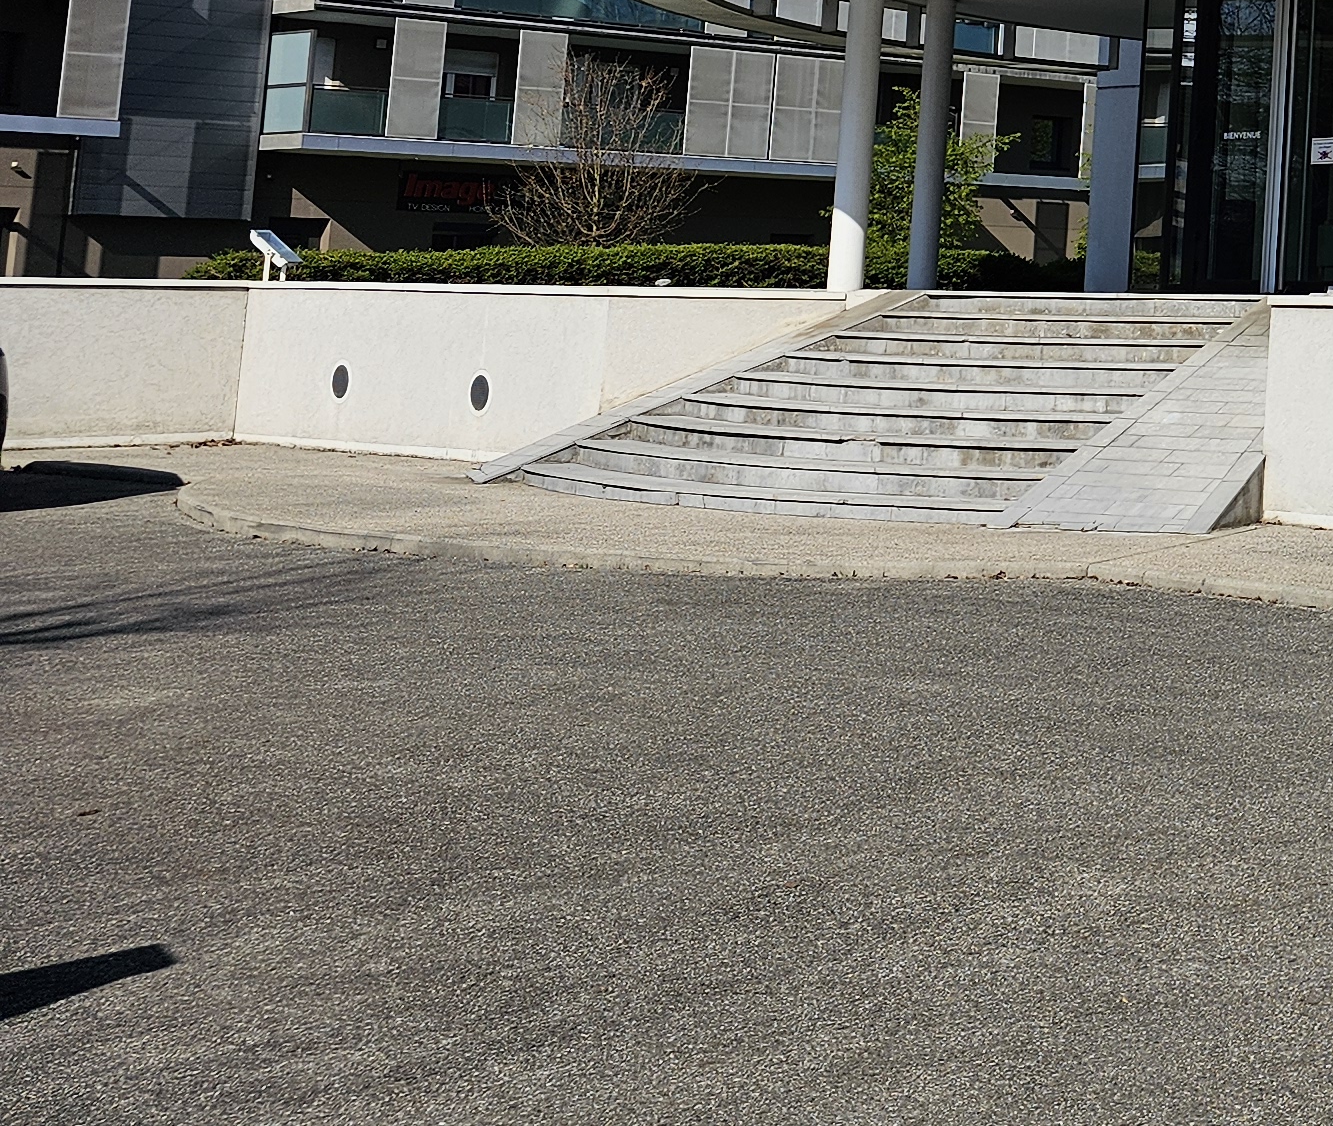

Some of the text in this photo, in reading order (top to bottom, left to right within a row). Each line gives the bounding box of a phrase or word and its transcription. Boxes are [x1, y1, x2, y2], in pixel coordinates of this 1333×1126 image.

[1223, 130, 1262, 140] BIENVENUE
[403, 172, 496, 206] Image
[407, 203, 419, 211] TV
[421, 204, 451, 212] DESIGN
